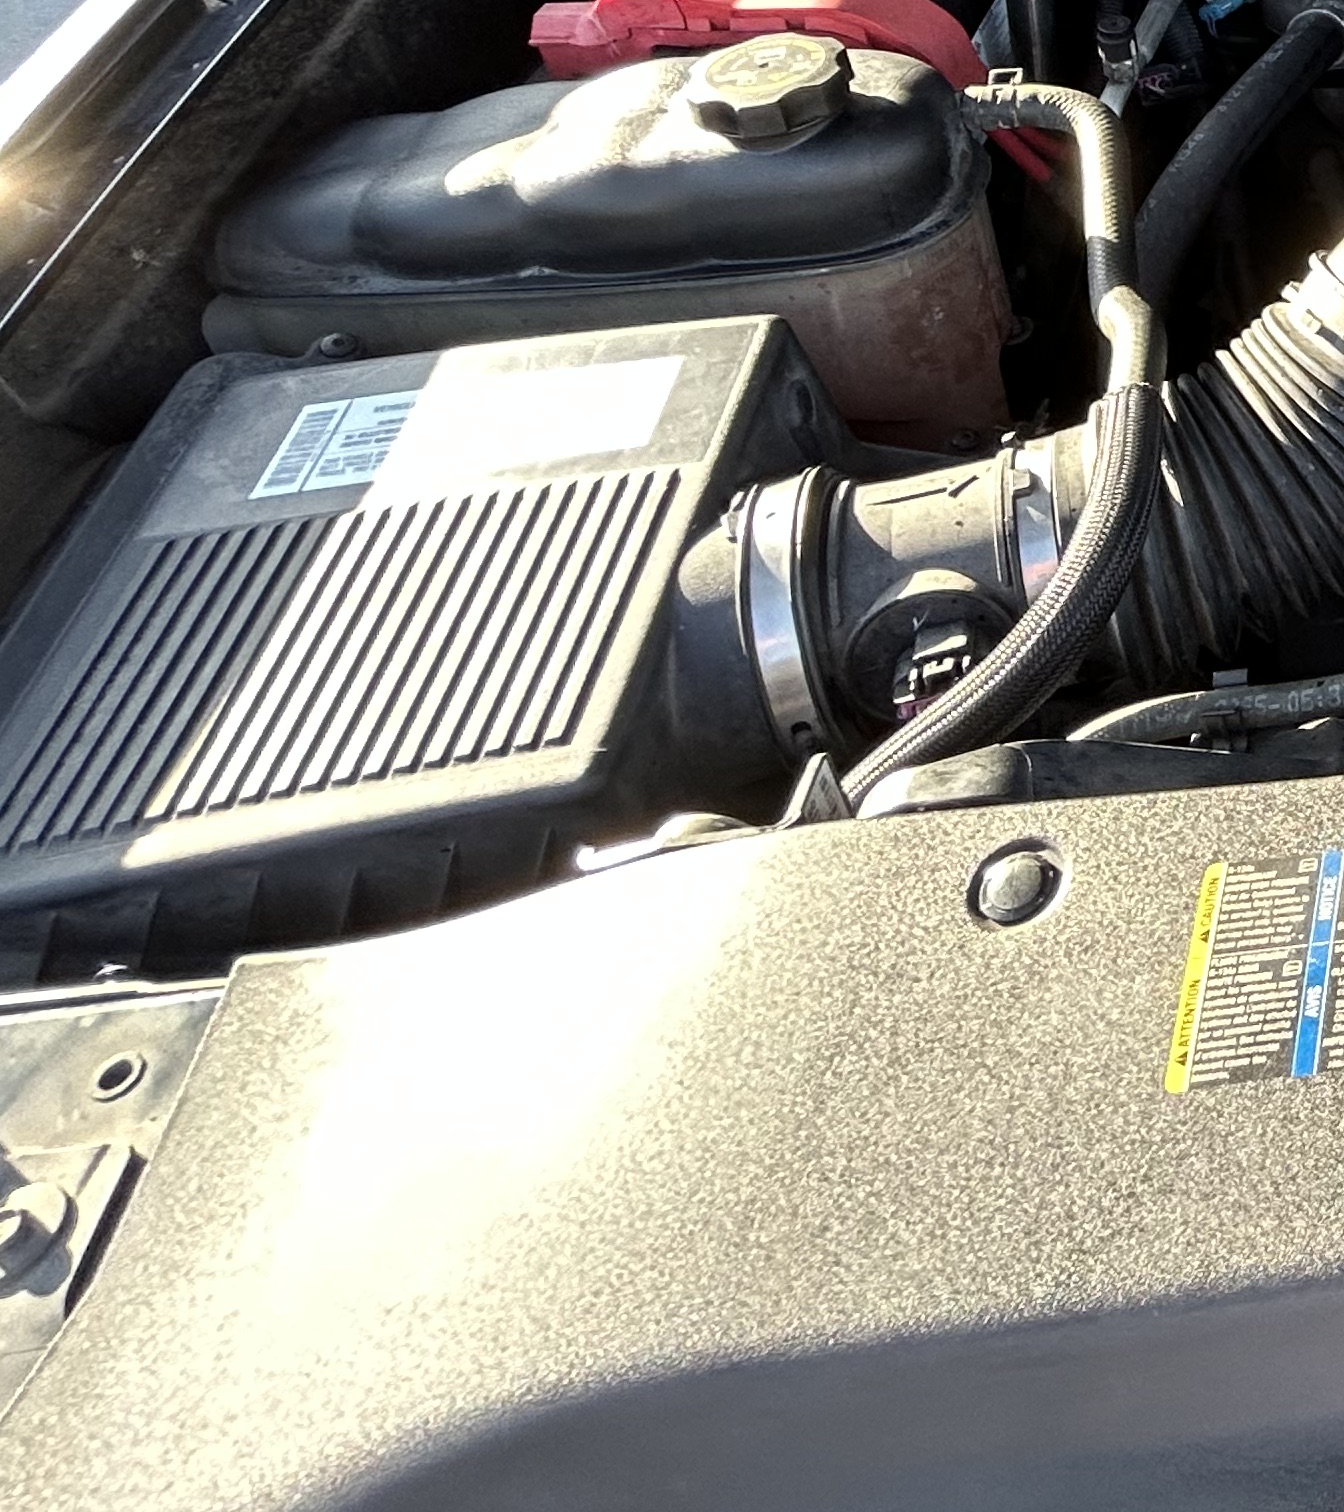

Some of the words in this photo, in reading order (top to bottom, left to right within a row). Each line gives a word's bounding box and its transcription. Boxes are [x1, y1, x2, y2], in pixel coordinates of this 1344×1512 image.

[1200, 877, 1220, 927] CAUTION
[1318, 875, 1338, 921] NOTICE
[1179, 978, 1202, 1048] ATTENTION
[1303, 984, 1322, 1018] AVIS
